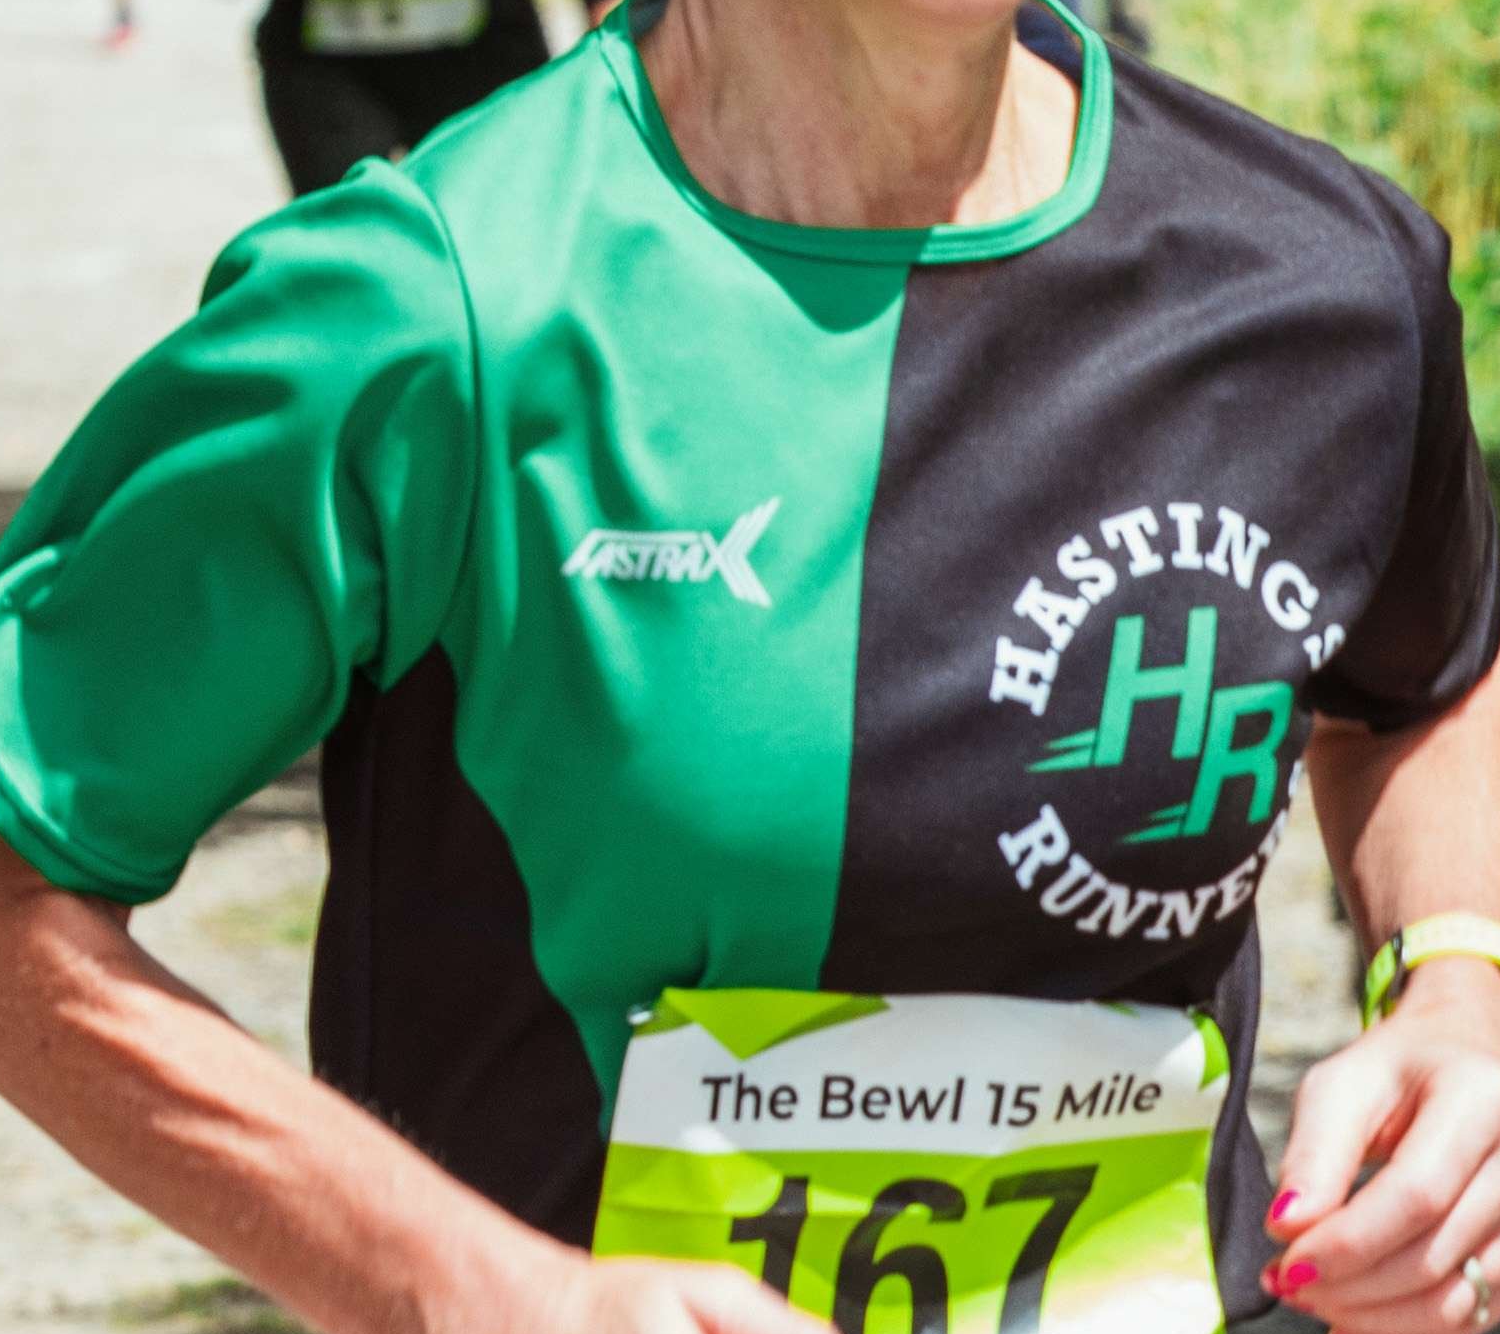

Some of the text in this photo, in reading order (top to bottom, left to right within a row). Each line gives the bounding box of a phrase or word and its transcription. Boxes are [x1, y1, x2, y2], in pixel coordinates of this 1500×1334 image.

[701, 1071, 1164, 1127] The Bewl 15 Mile
